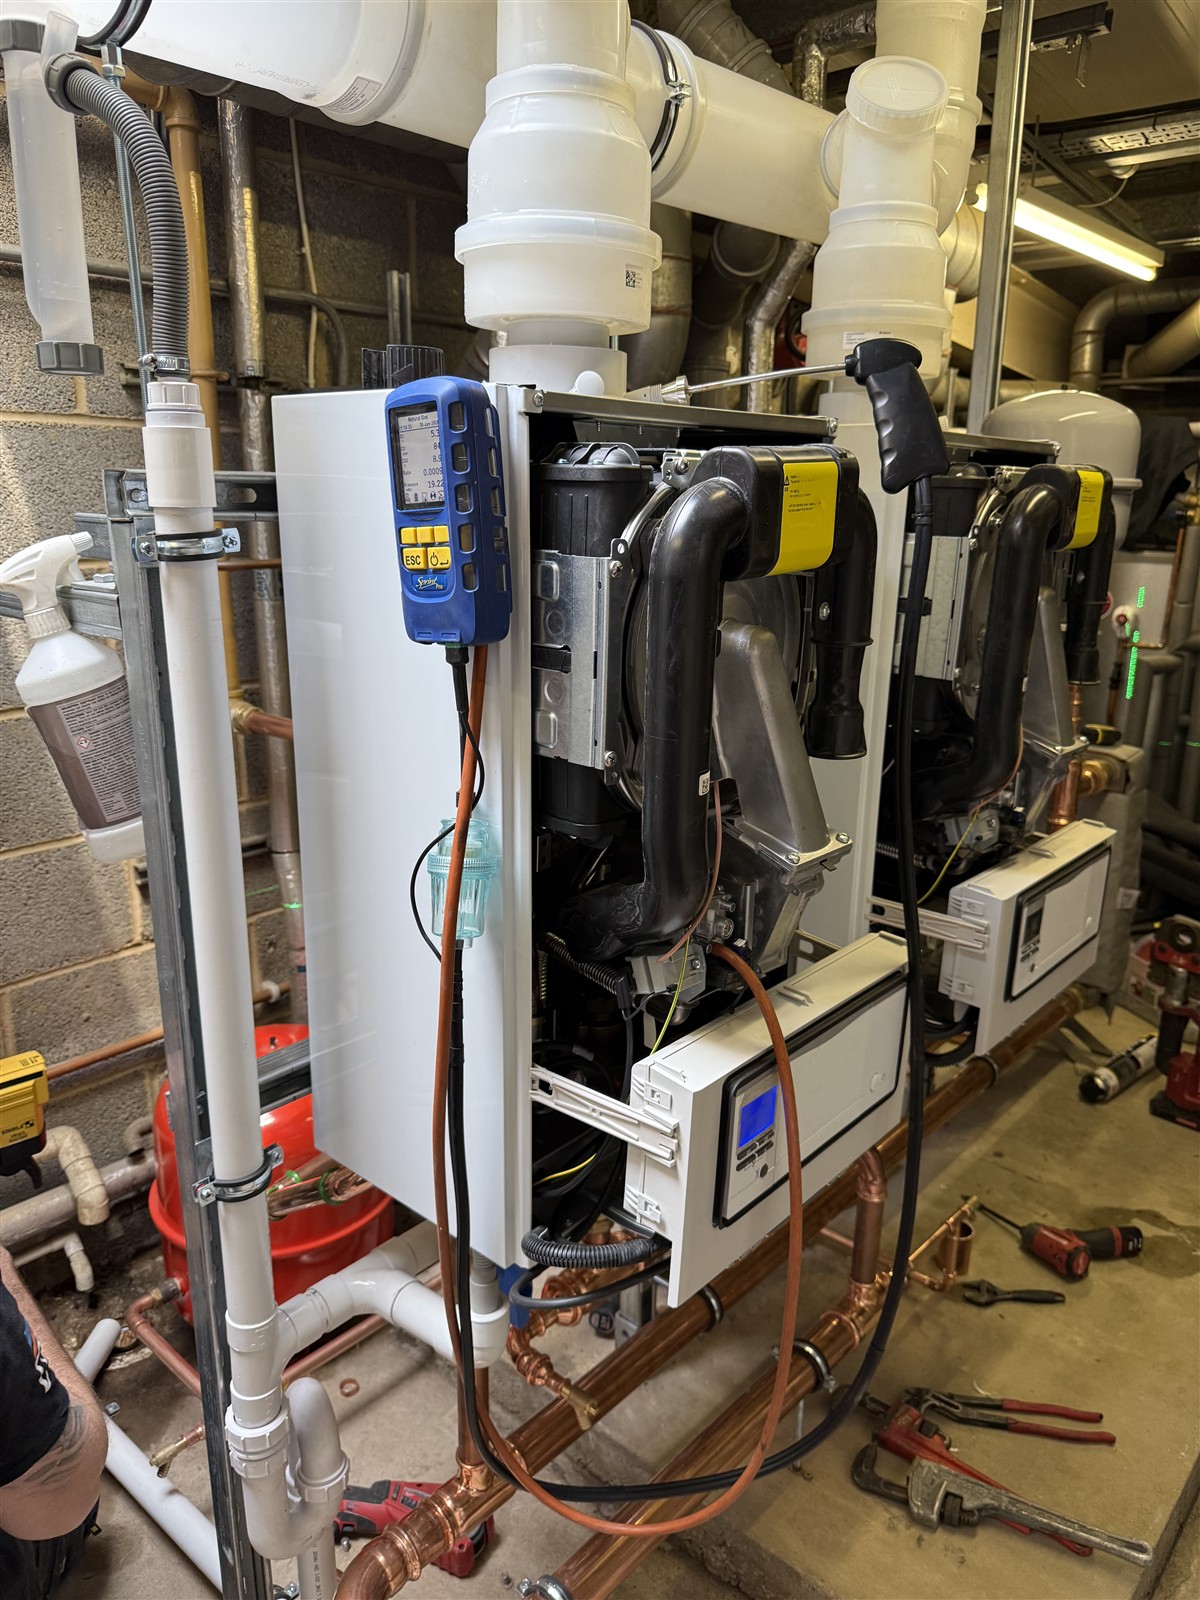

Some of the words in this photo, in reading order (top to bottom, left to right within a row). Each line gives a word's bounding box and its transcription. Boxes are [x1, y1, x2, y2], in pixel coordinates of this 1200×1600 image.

[405, 555, 421, 566] ESC
[416, 576, 437, 589] Sprint
[2, 1124, 23, 1135] STABILA
